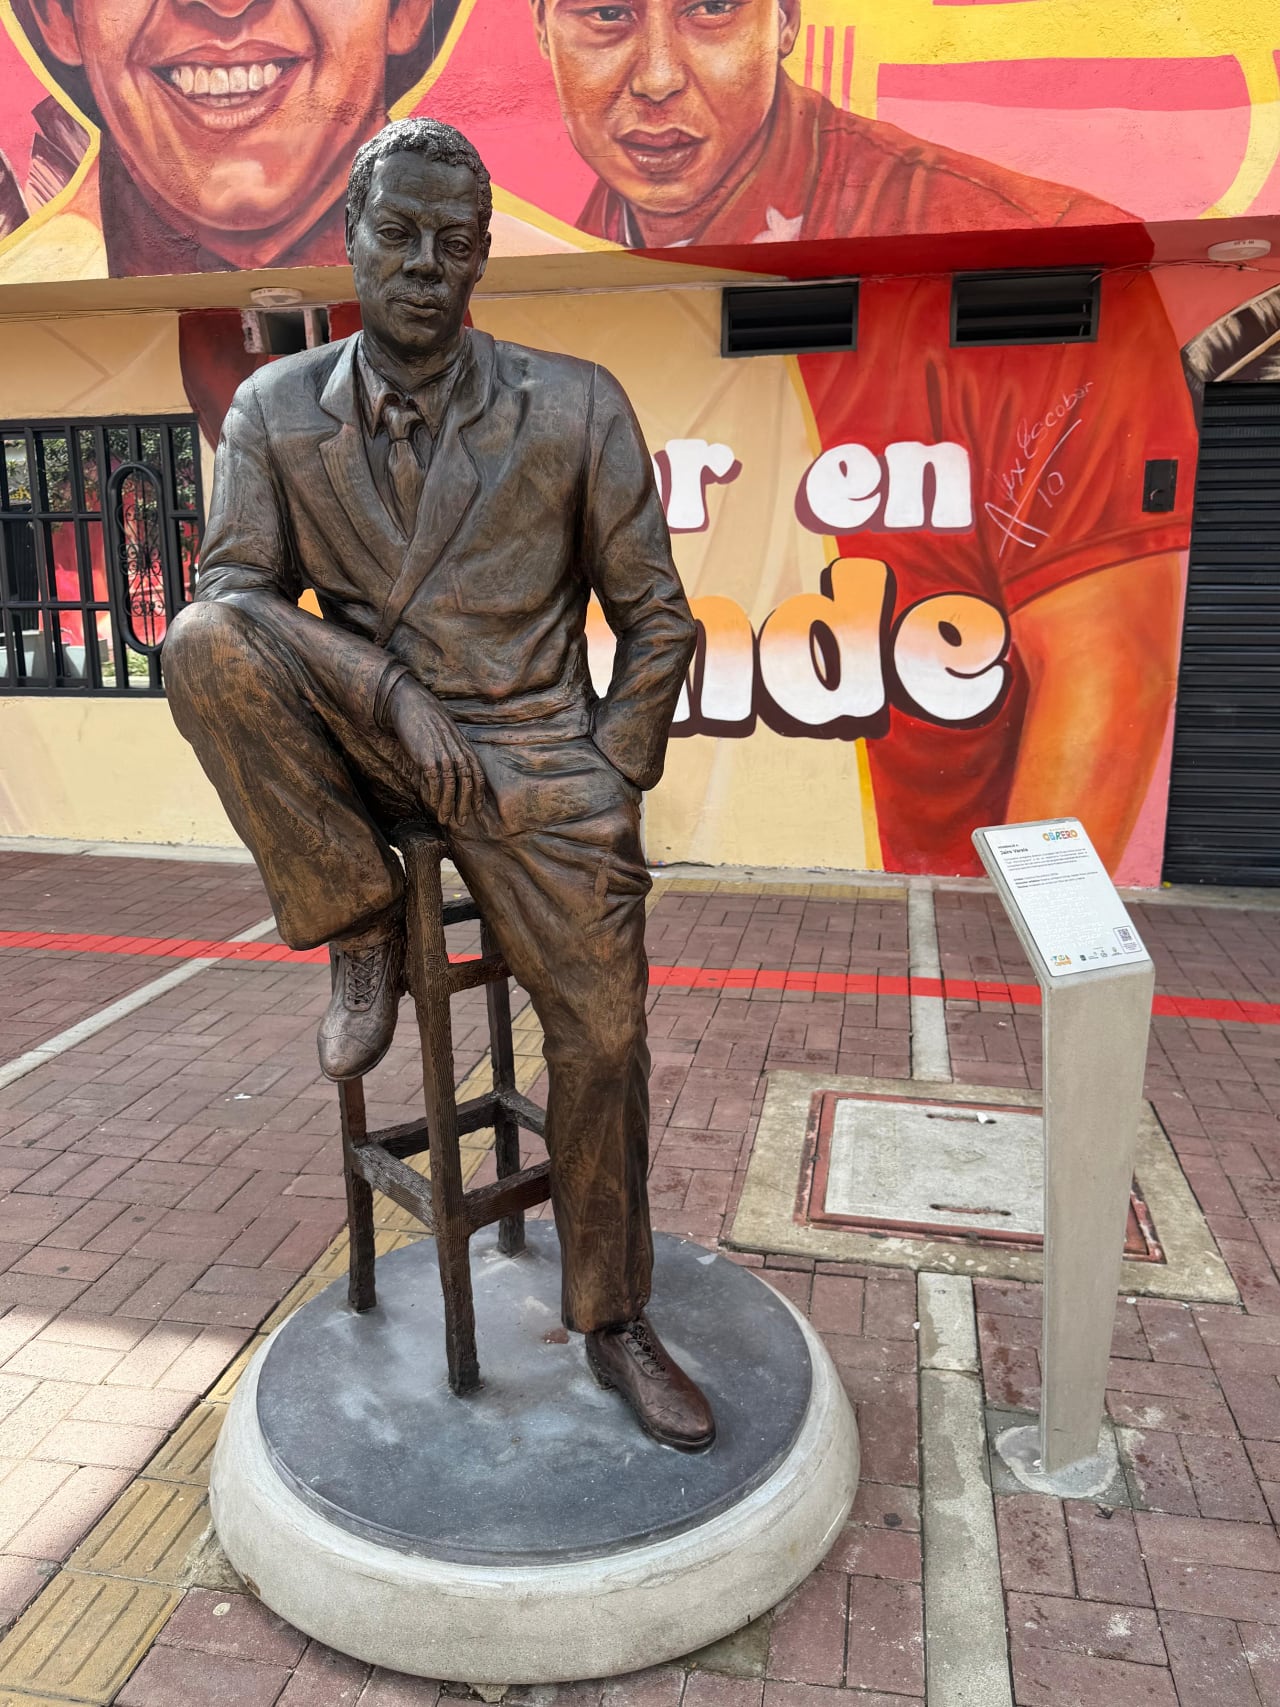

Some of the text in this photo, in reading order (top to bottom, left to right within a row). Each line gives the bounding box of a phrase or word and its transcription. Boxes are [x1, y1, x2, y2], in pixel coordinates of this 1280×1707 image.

[1017, 382, 1094, 460] Escobar
[654, 439, 974, 533] r en
[1037, 471, 1065, 508] 10
[672, 557, 1010, 741] nde
